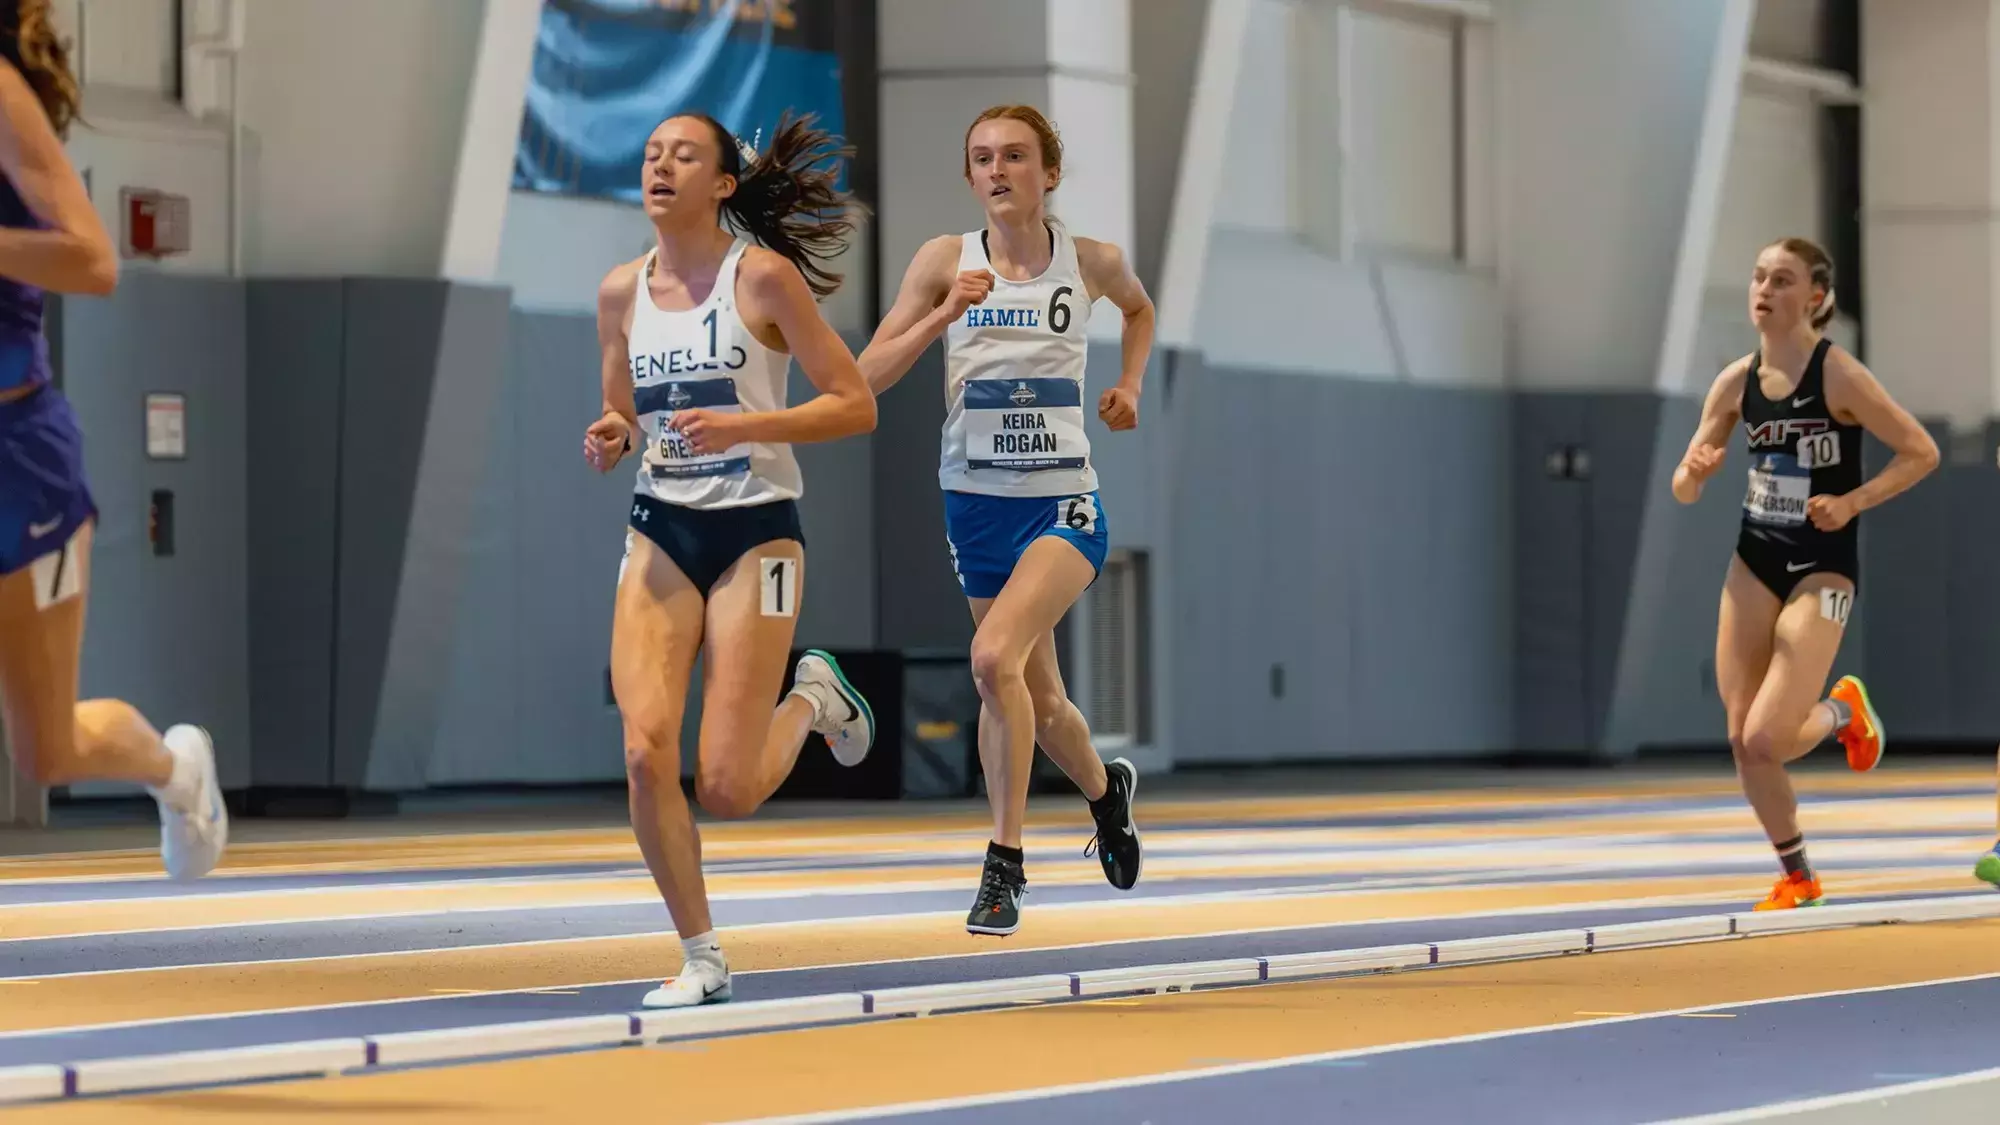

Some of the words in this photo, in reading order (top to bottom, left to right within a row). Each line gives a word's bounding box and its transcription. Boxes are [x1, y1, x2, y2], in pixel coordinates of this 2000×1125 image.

[967, 308, 1040, 328] HAMIL
[1048, 286, 1073, 334] 6
[702, 308, 717, 358] 1
[1002, 413, 1046, 430] KEIRA
[1745, 418, 1829, 448] MIT
[993, 433, 1057, 454] ROGAN
[1806, 436, 1833, 466] 10
[1066, 496, 1090, 529] 6
[770, 561, 784, 613] 1
[1829, 592, 1848, 623] 10
